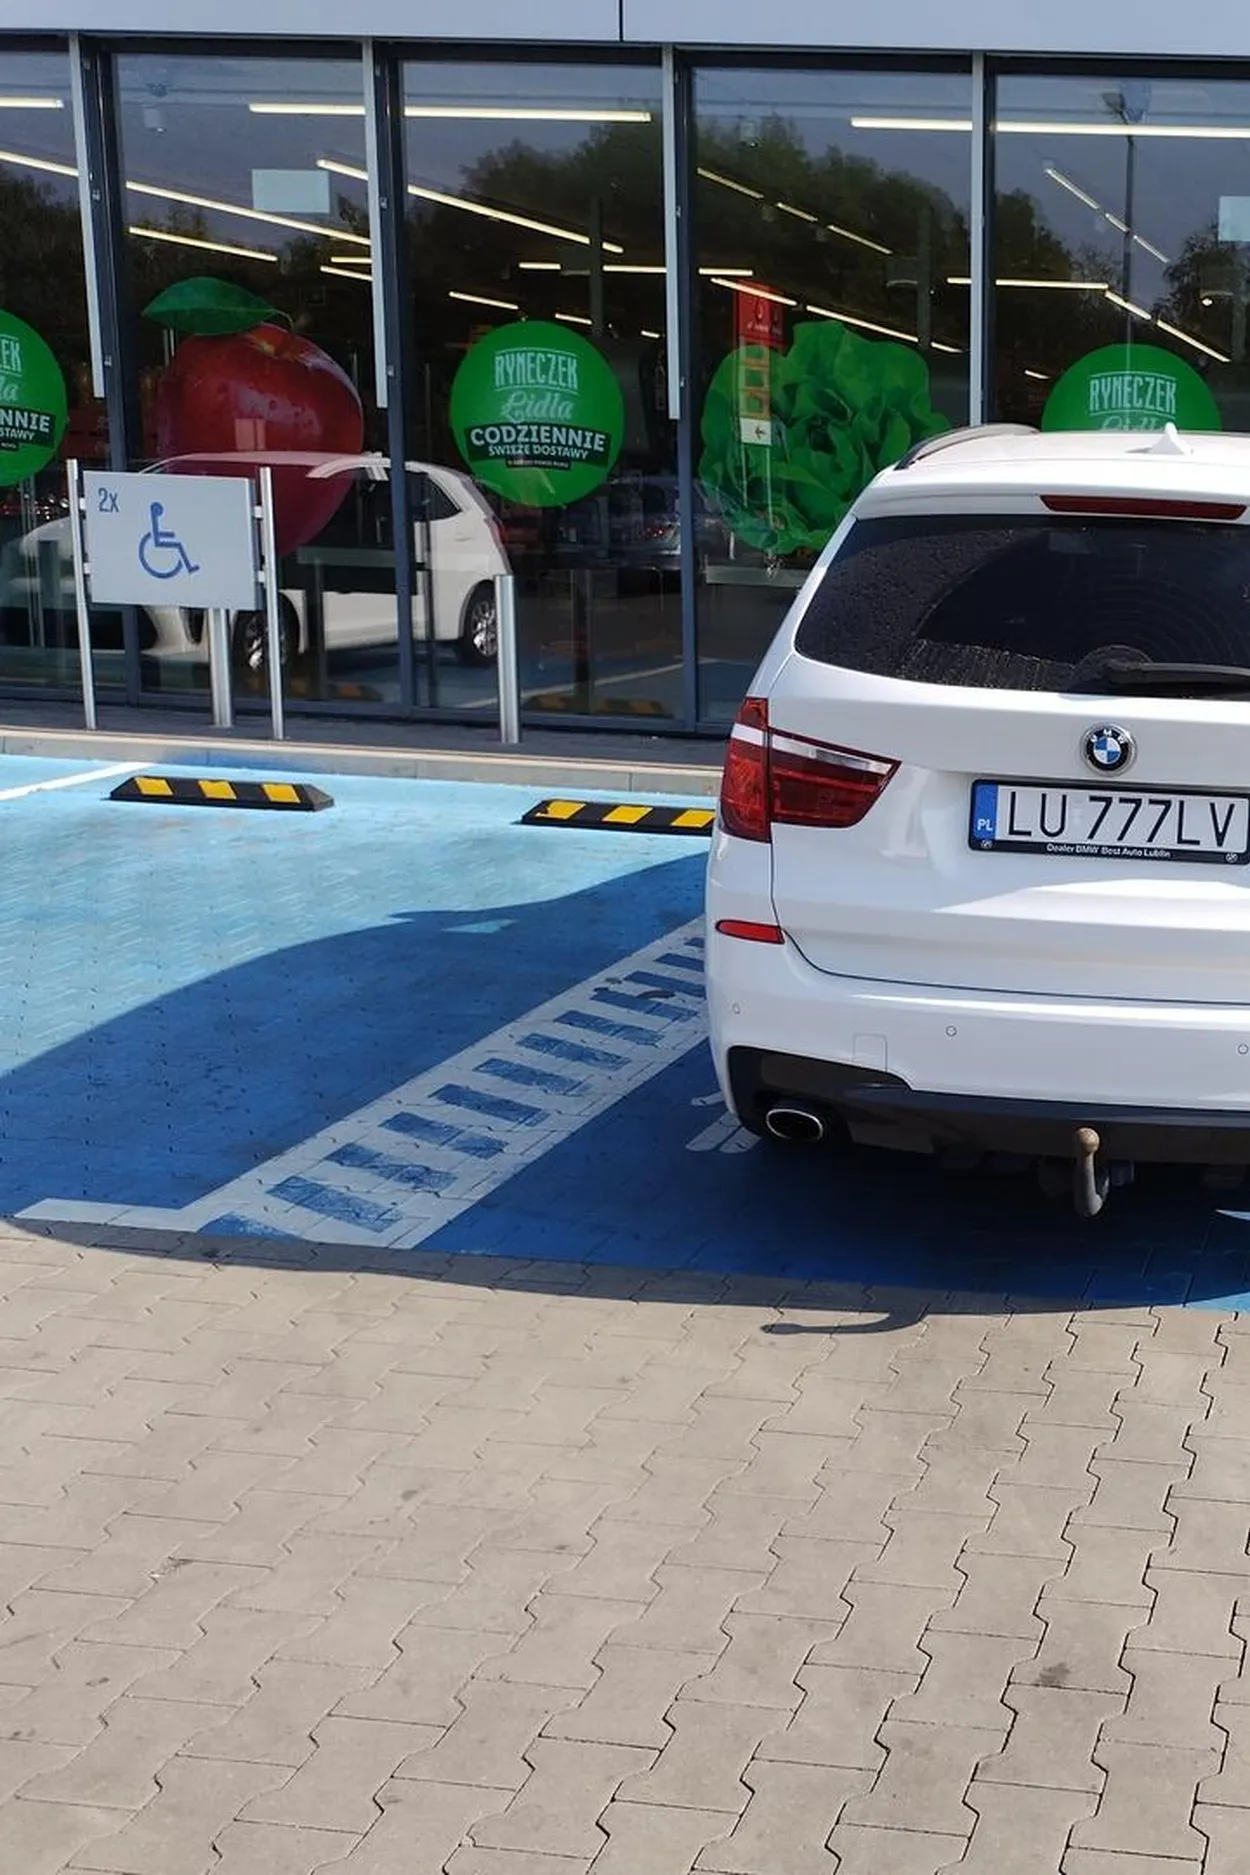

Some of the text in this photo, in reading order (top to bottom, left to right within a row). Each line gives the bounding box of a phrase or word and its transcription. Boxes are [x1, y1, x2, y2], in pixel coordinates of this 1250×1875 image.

[494, 351, 579, 389] RYNECZEK
[500, 390, 575, 424] Lidla
[1089, 374, 1177, 414] RYNECZEK
[469, 425, 606, 452] CODZIENNIE
[532, 444, 589, 460] DOSTAWY
[98, 487, 119, 512] 2x
[977, 818, 993, 831] PL
[1008, 791, 1236, 848] LU 777LV
